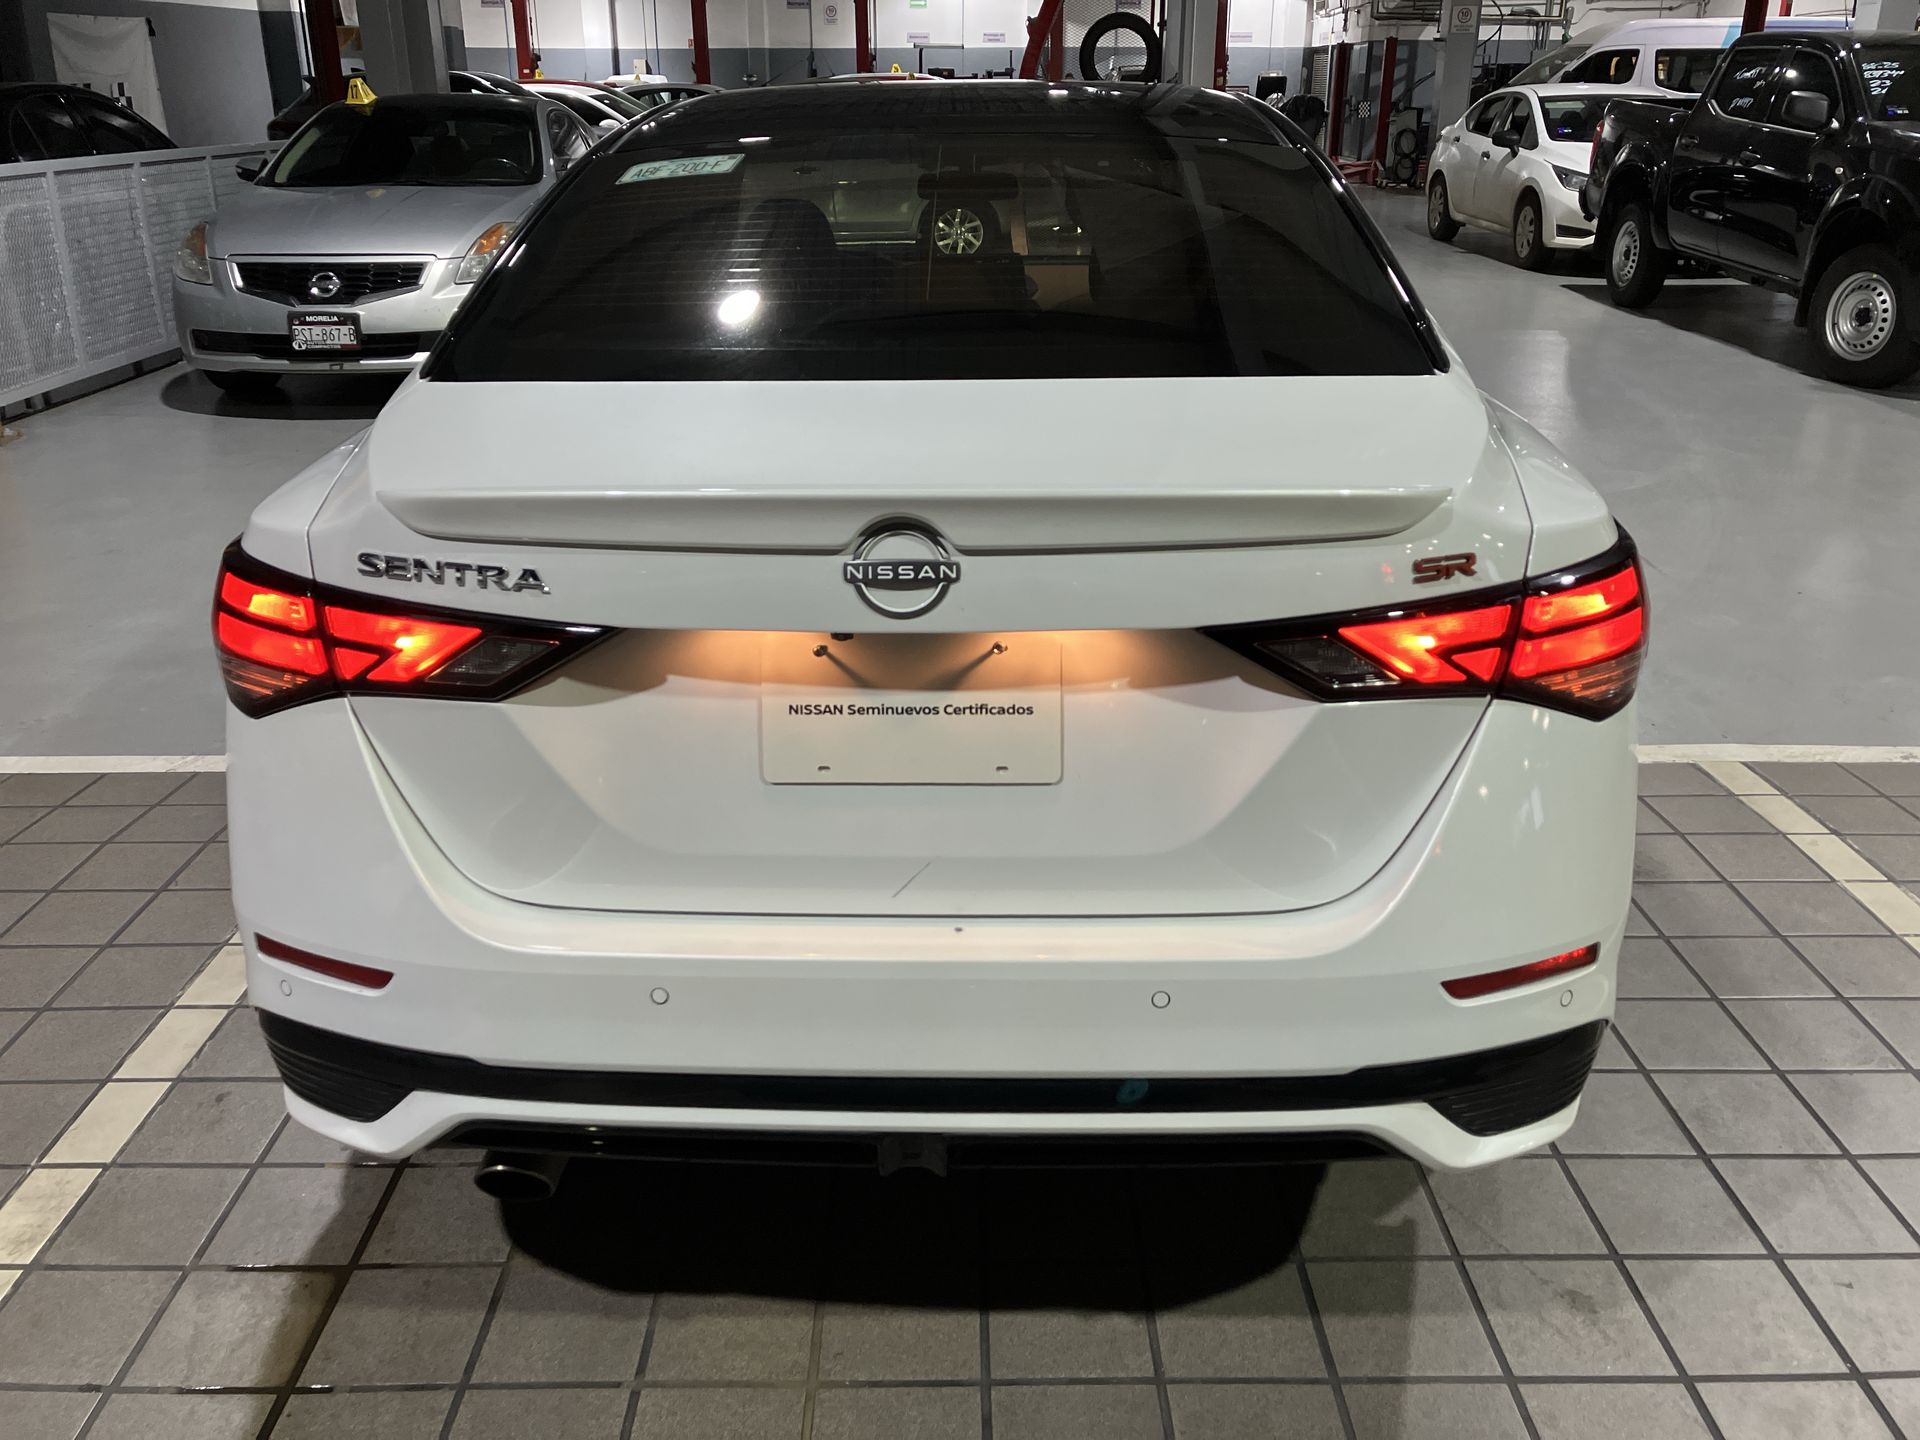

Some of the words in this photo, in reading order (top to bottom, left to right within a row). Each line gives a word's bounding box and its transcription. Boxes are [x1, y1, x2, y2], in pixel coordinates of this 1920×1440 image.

[631, 160, 725, 179] ABF-200-F
[357, 552, 552, 594] SENTRA
[847, 565, 957, 579] NISSAN
[1412, 552, 1477, 584] SR
[788, 704, 844, 716] NISSAN
[847, 703, 940, 716] Seminuevos
[943, 703, 1034, 716] Certificados
